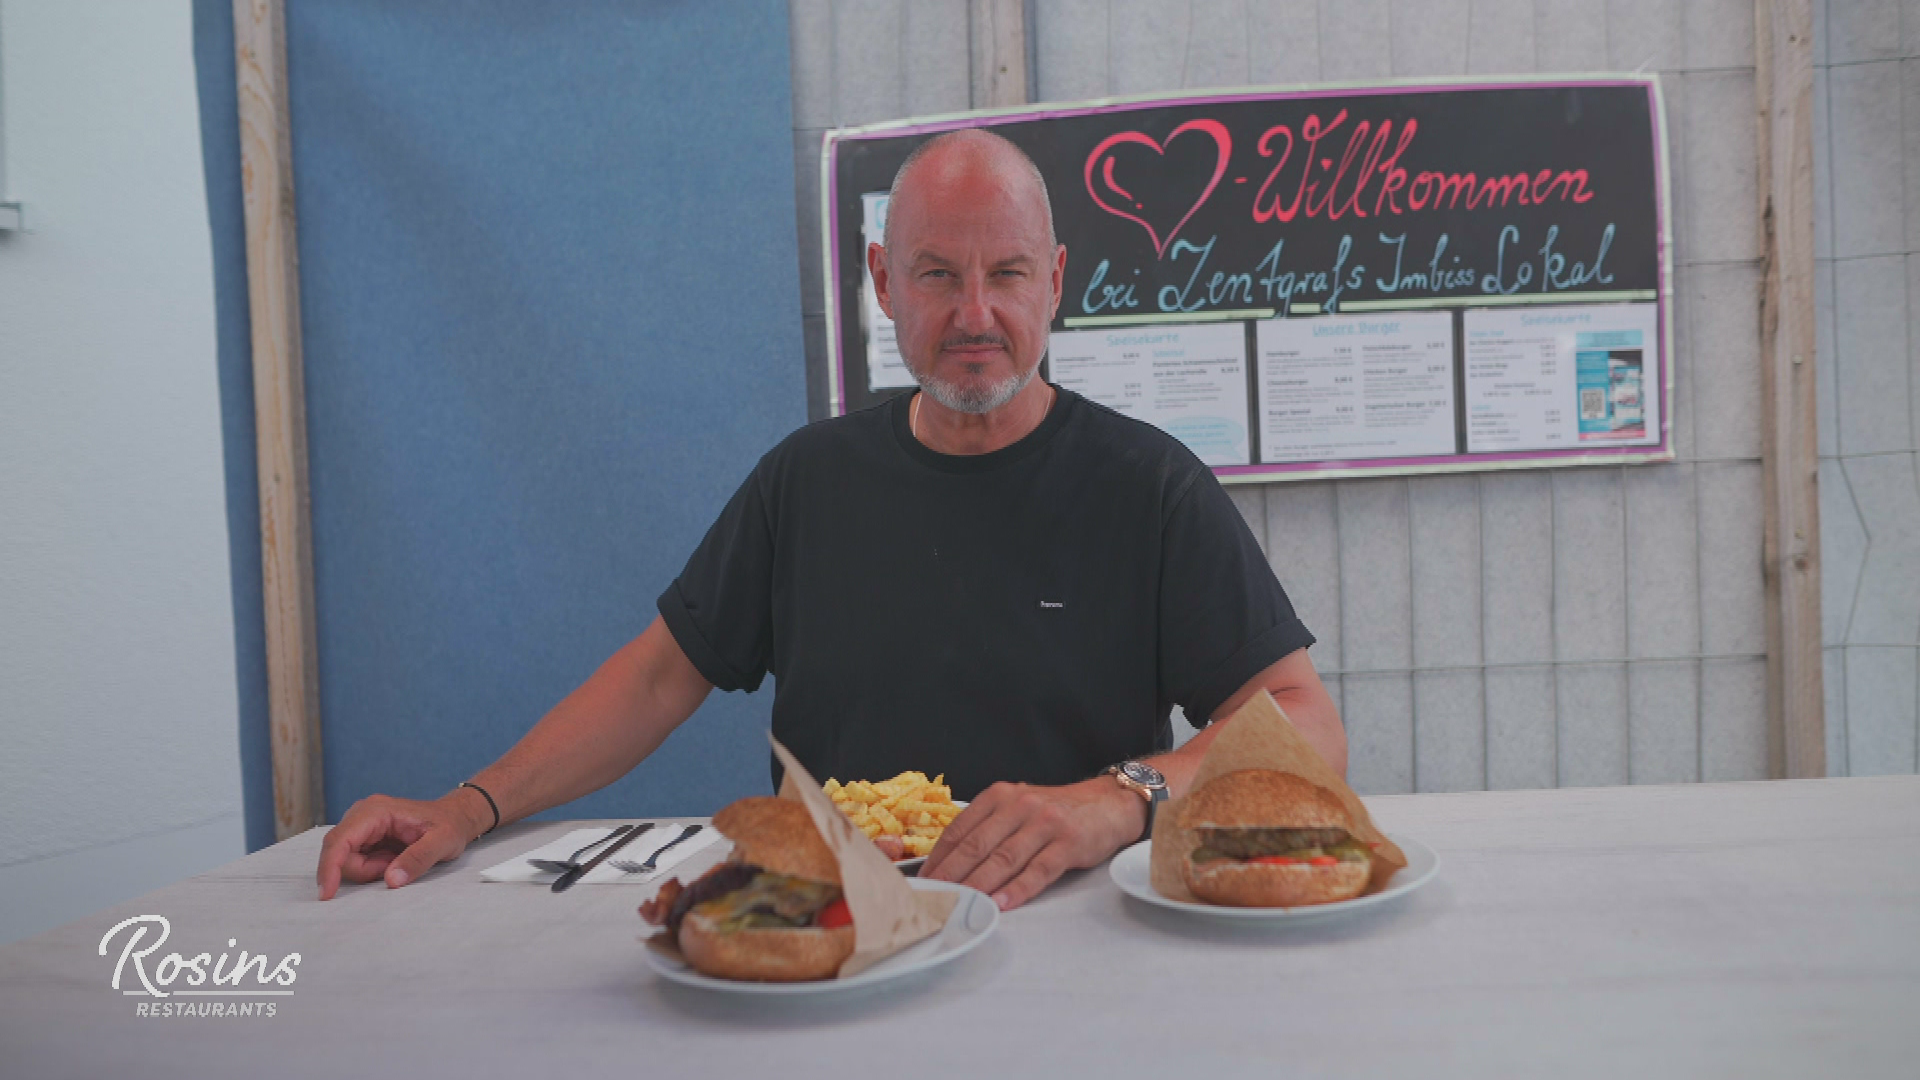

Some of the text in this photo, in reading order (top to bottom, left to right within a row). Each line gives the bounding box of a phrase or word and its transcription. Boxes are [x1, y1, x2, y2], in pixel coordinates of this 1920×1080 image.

[1082, 258, 1139, 314] bei
[1376, 232, 1476, 293] Imbiss
[1312, 321, 1402, 338] Unsere Burger
[1106, 331, 1180, 348] Speisekarte
